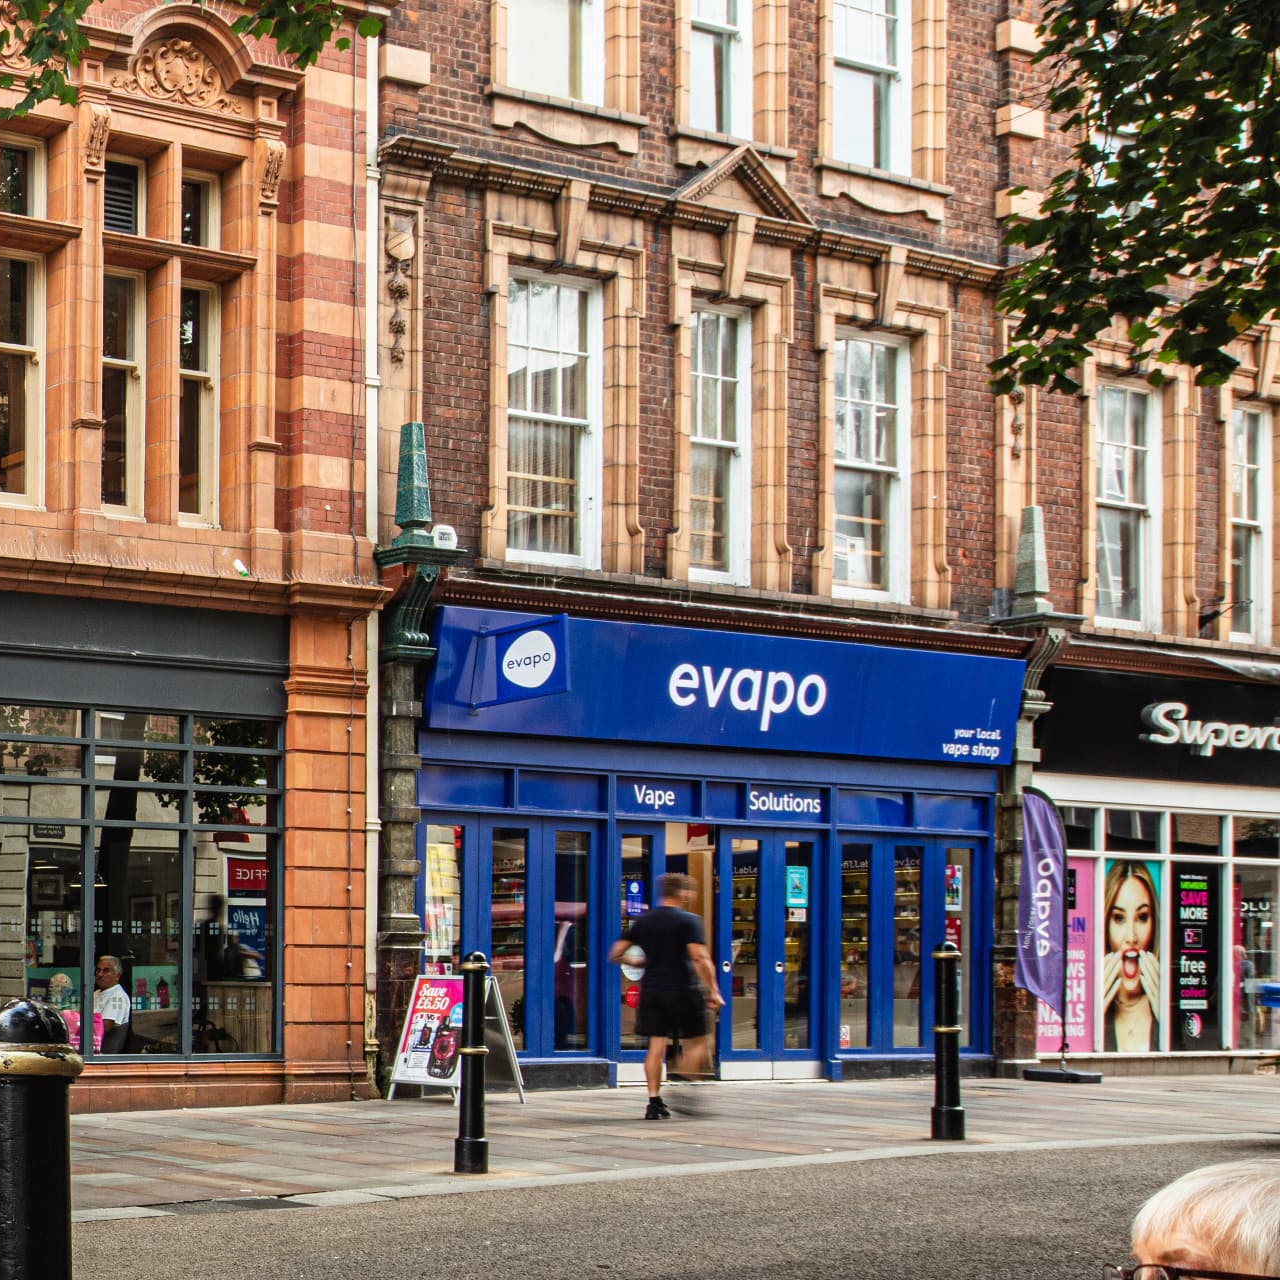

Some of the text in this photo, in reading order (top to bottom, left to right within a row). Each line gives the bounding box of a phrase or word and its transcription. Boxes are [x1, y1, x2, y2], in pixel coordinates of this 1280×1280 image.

[507, 652, 551, 669] evapo
[668, 663, 828, 732] evapo
[954, 728, 1002, 740] your local
[942, 742, 1000, 760] vape shop
[634, 783, 822, 814] Vape Solutions
[1180, 891, 1208, 906] SAVE
[1180, 907, 1208, 920] MORE
[1180, 955, 1207, 973] free
[419, 984, 447, 997] Save
[415, 996, 450, 1010] £6.50
[1038, 1004, 1086, 1023] NALS
